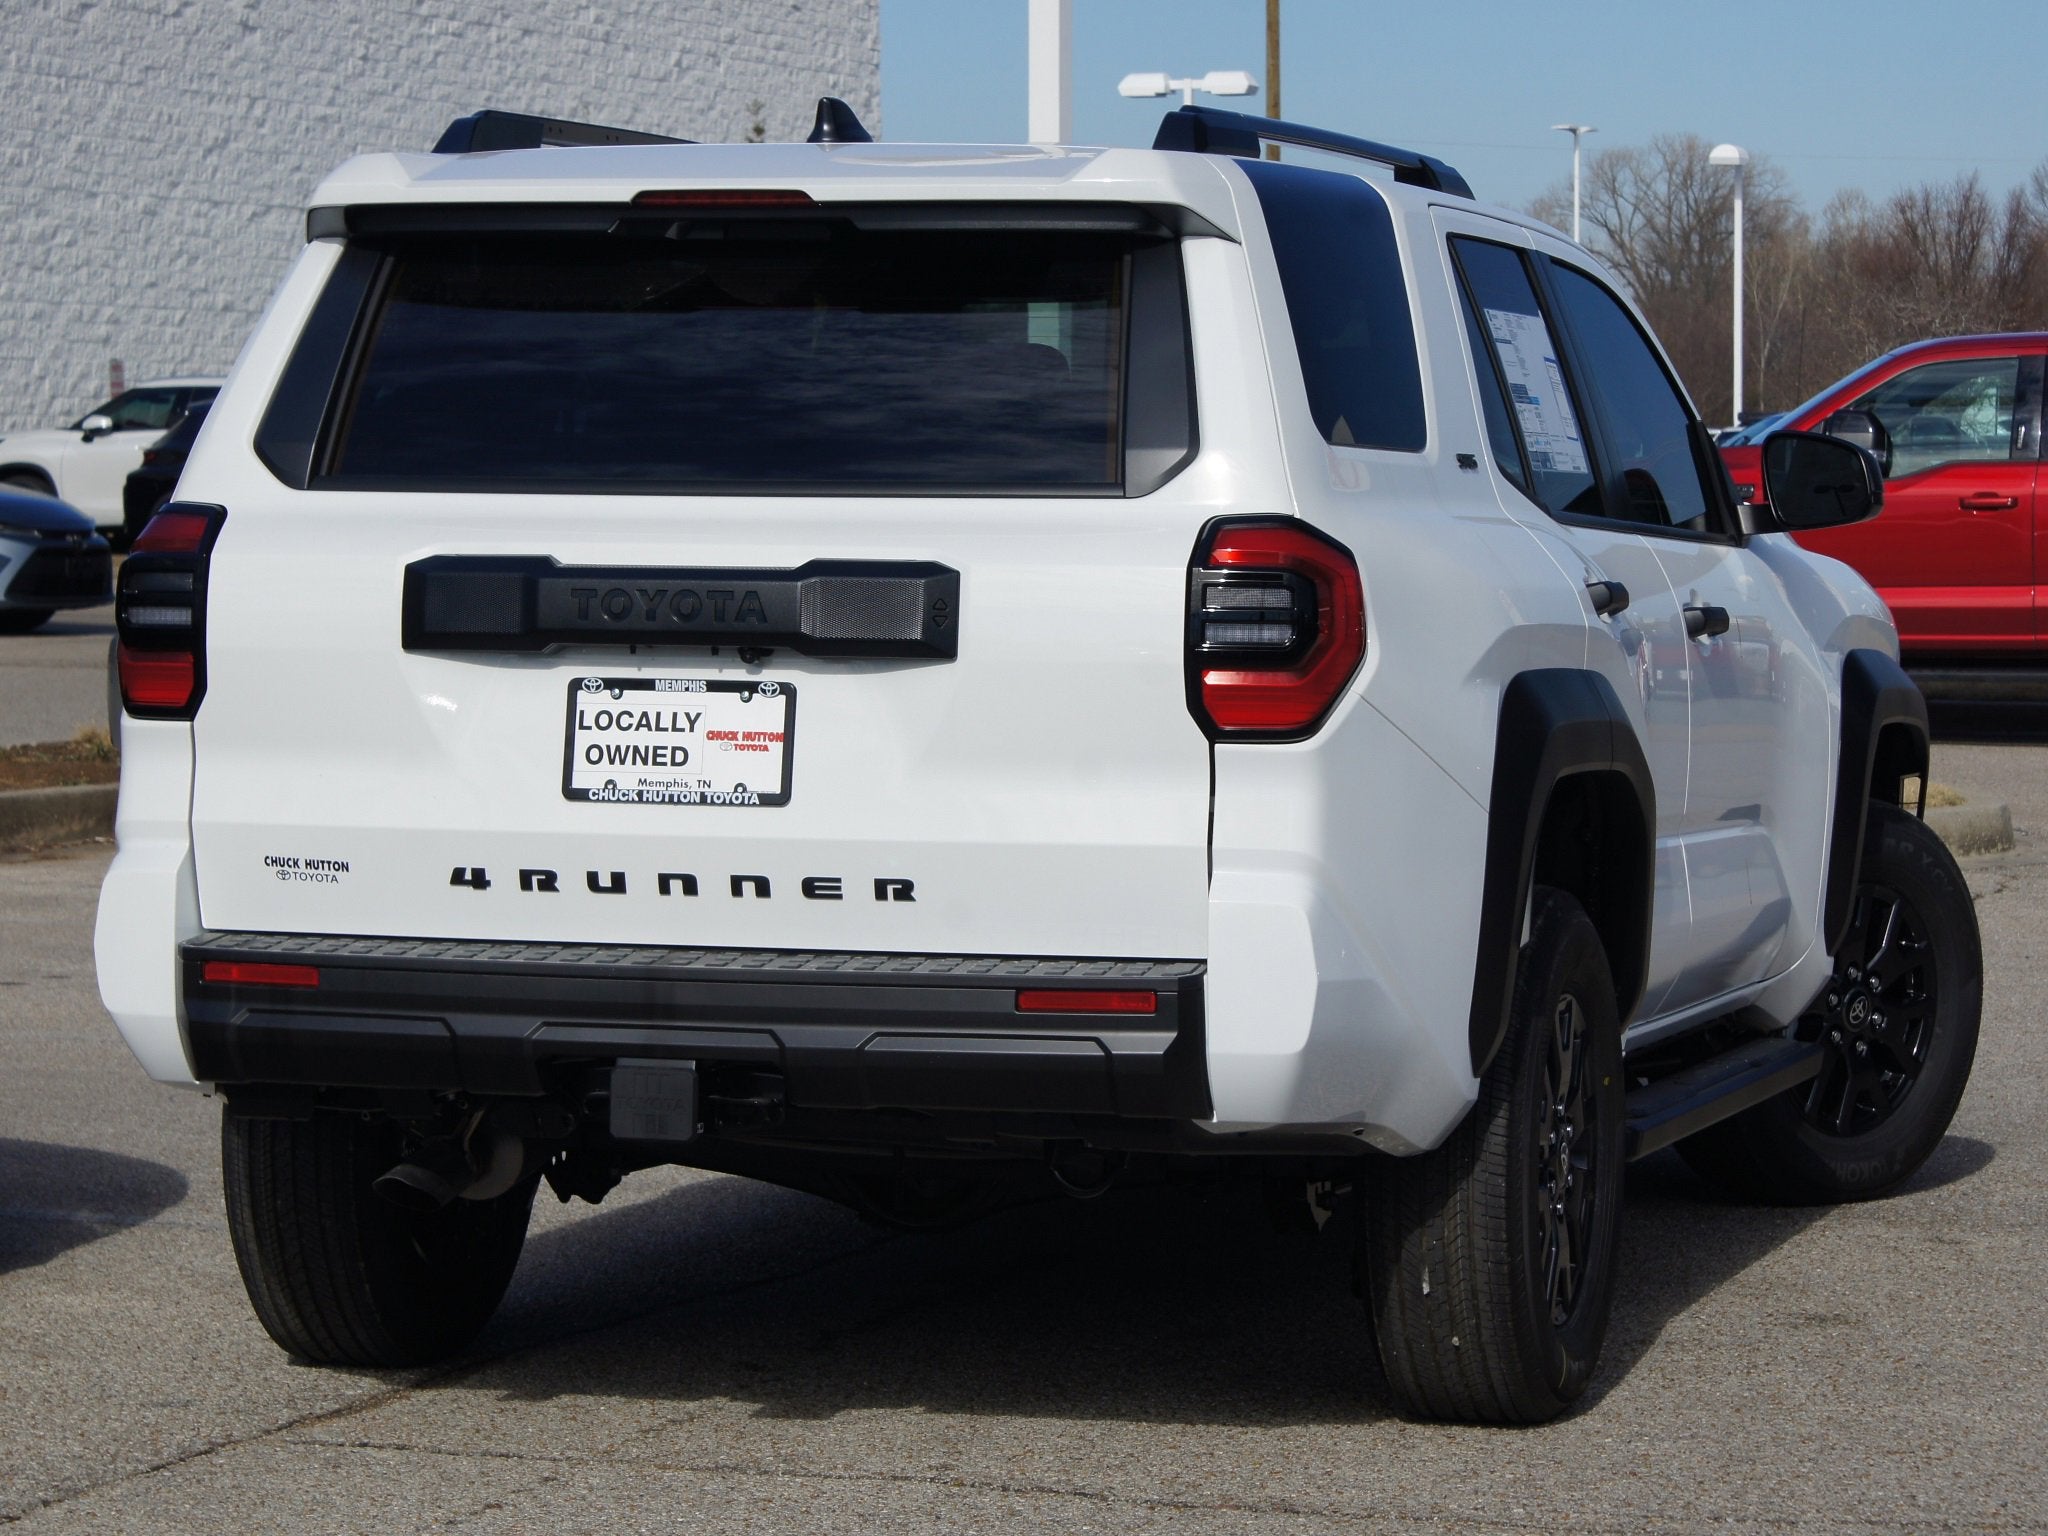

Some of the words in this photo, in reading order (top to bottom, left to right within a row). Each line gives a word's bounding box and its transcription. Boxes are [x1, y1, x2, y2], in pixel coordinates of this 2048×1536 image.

[571, 587, 768, 624] TOYOTA
[655, 679, 707, 693] MEMPHIS
[578, 709, 702, 733] LOCALLY
[706, 730, 739, 741] CHUCK
[742, 731, 784, 743] HUTTON
[585, 743, 689, 767] OWNED
[733, 743, 769, 753] TOYOTA
[637, 777, 692, 790] Memphis,
[696, 779, 712, 789] TN
[588, 788, 639, 801] CHUCK
[642, 789, 700, 804] HUTTON
[704, 792, 760, 805] TOYOTA
[264, 855, 300, 869] CHUCK
[304, 858, 350, 873] HUTTON
[292, 871, 339, 884] TOYOTA
[450, 866, 917, 902] 4RUNNER
